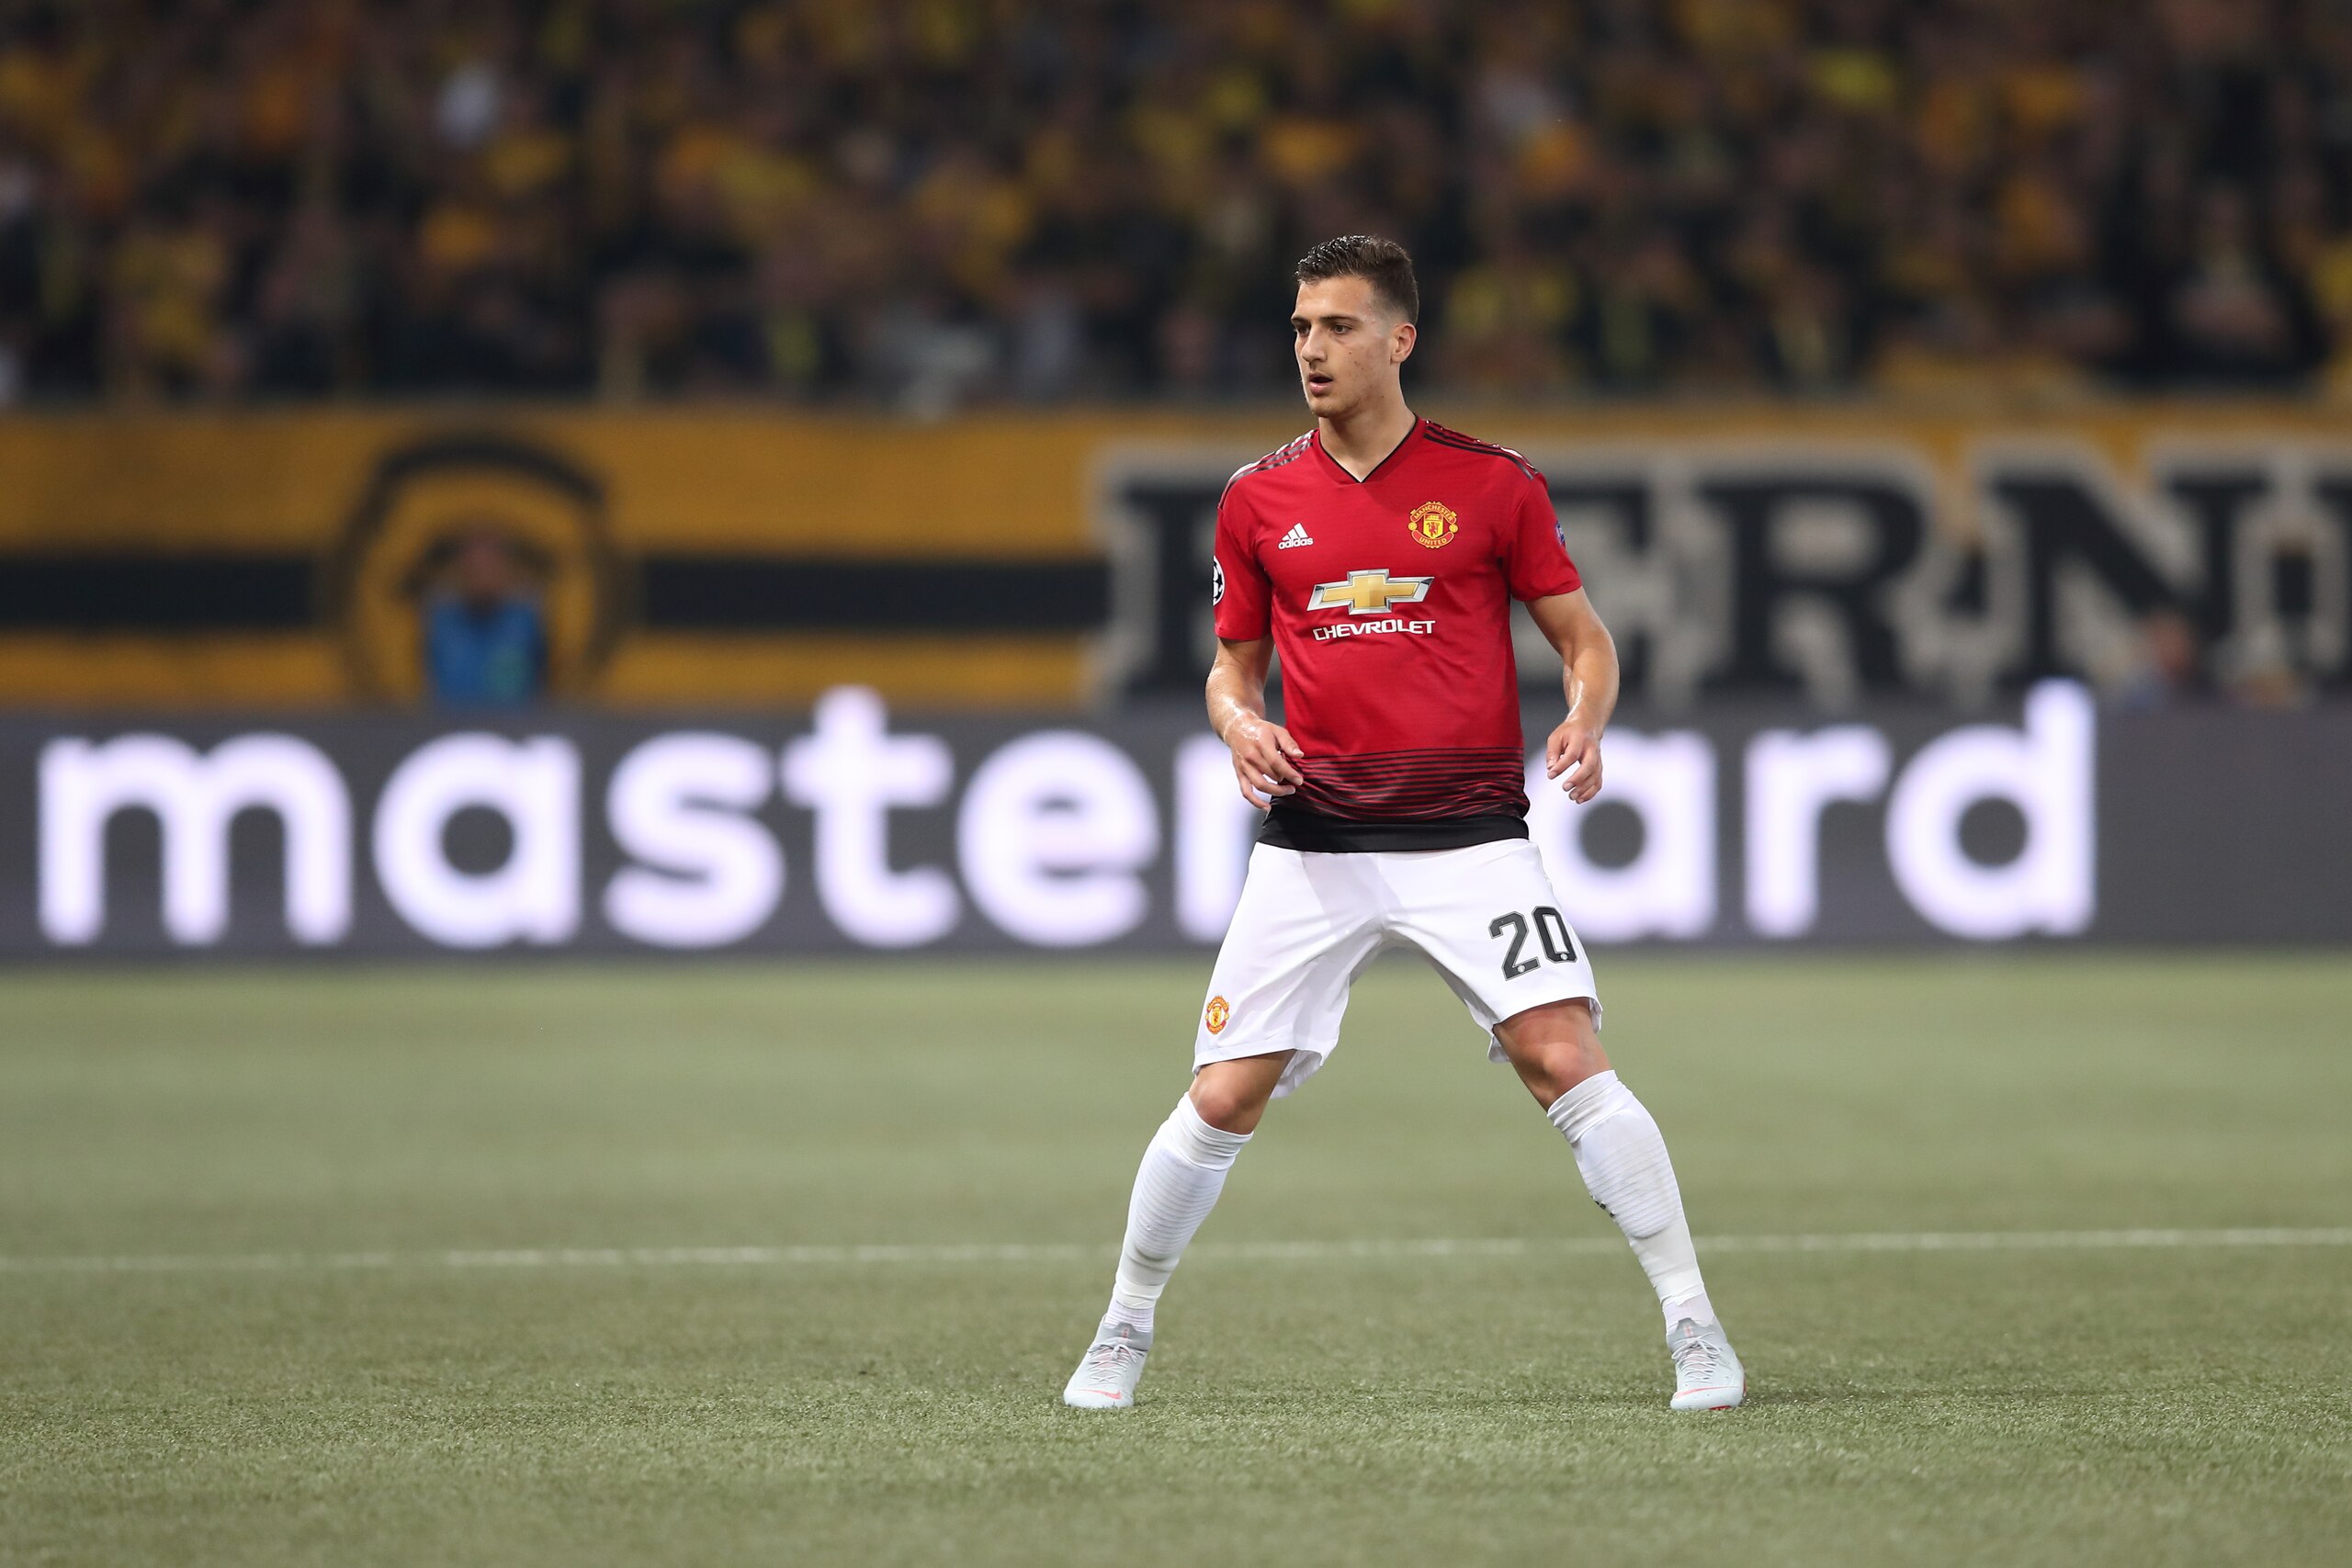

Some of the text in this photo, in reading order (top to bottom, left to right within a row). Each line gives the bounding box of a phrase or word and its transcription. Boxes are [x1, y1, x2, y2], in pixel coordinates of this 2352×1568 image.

[1413, 504, 1453, 523] MANCHESTER
[1278, 537, 1314, 550] adidas
[1419, 536, 1447, 546] UNITED
[1312, 619, 1436, 641] CHEVROLET
[38, 680, 2096, 948] masterard
[1487, 906, 1578, 982] 20
